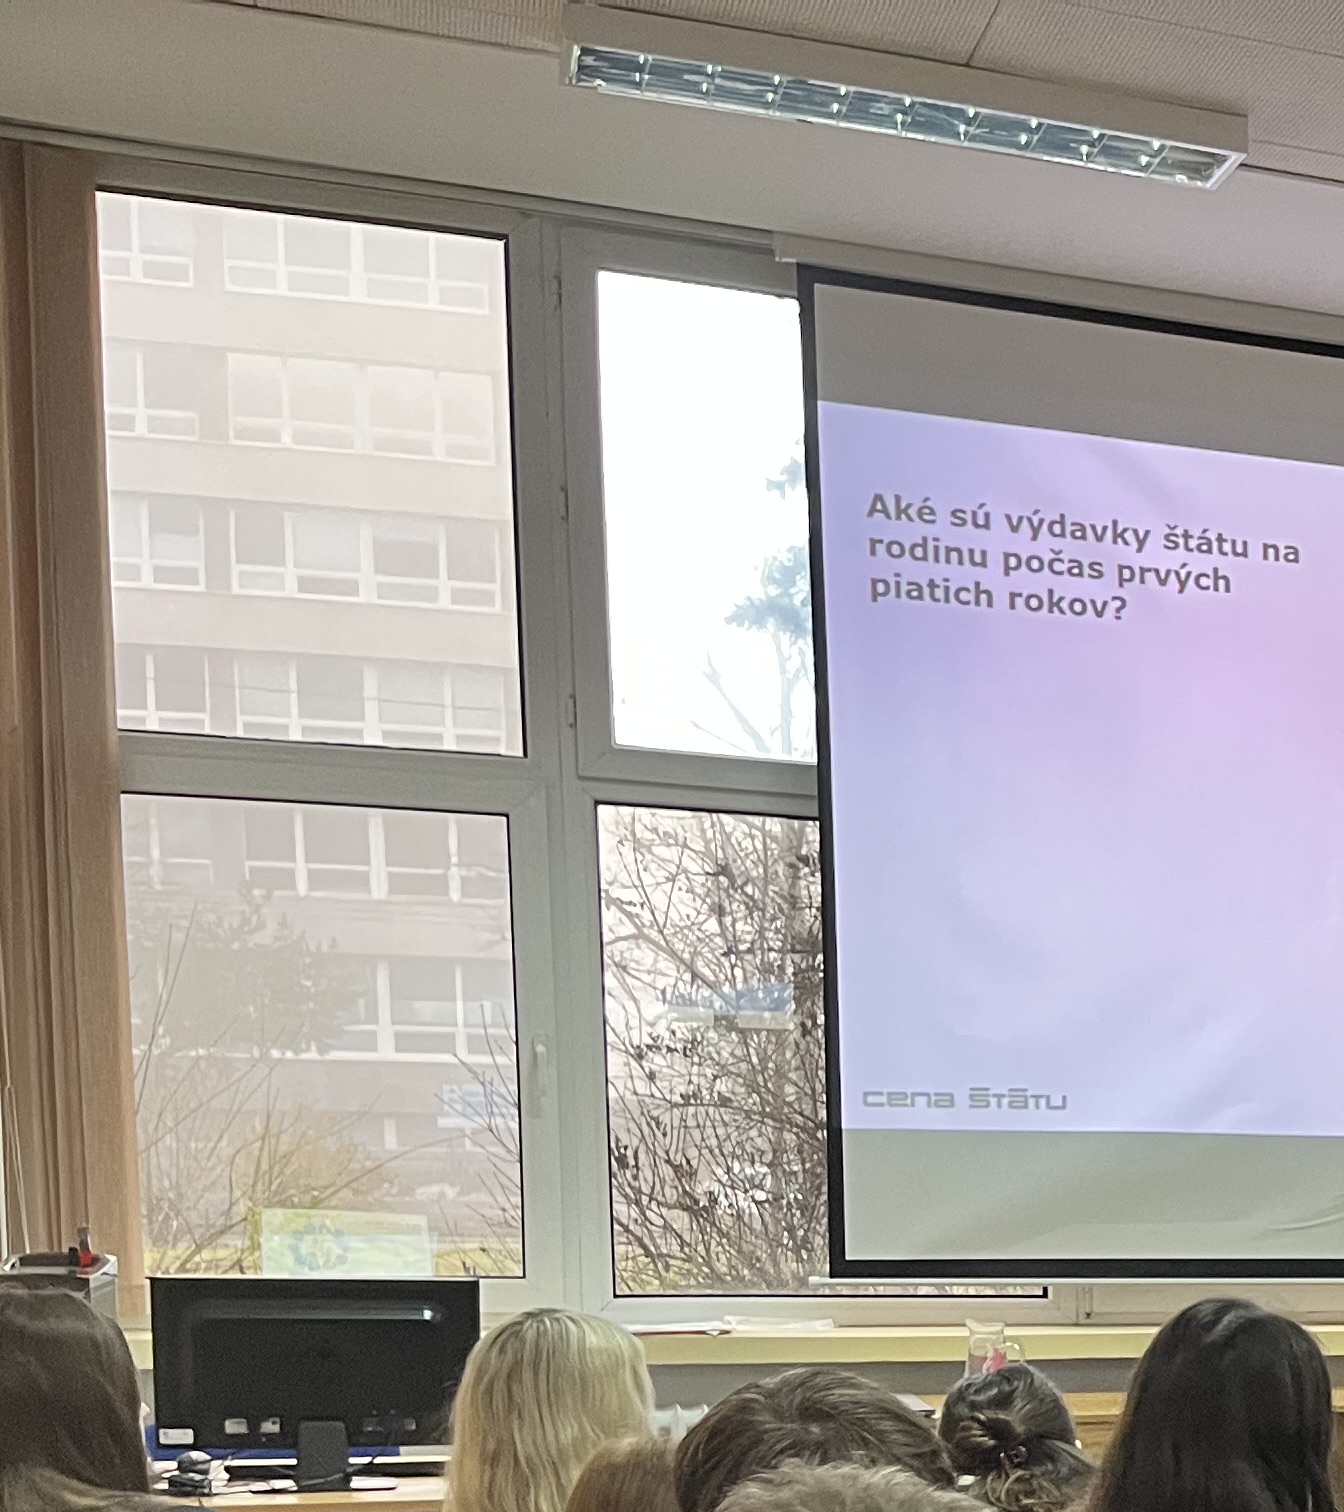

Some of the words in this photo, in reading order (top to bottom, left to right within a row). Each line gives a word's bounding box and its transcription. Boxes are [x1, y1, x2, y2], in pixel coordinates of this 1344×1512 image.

[867, 492, 936, 525] Aké
[949, 503, 991, 530] sú
[1004, 507, 1151, 553] výdavky
[1163, 523, 1248, 558] štátu
[1263, 541, 1300, 564] na
[869, 534, 988, 569] rodinu
[1003, 547, 1104, 581] počas
[1117, 563, 1232, 594] prvých
[870, 573, 993, 608] piatich
[1008, 588, 1128, 621] rokov?
[863, 1091, 955, 1109] cena
